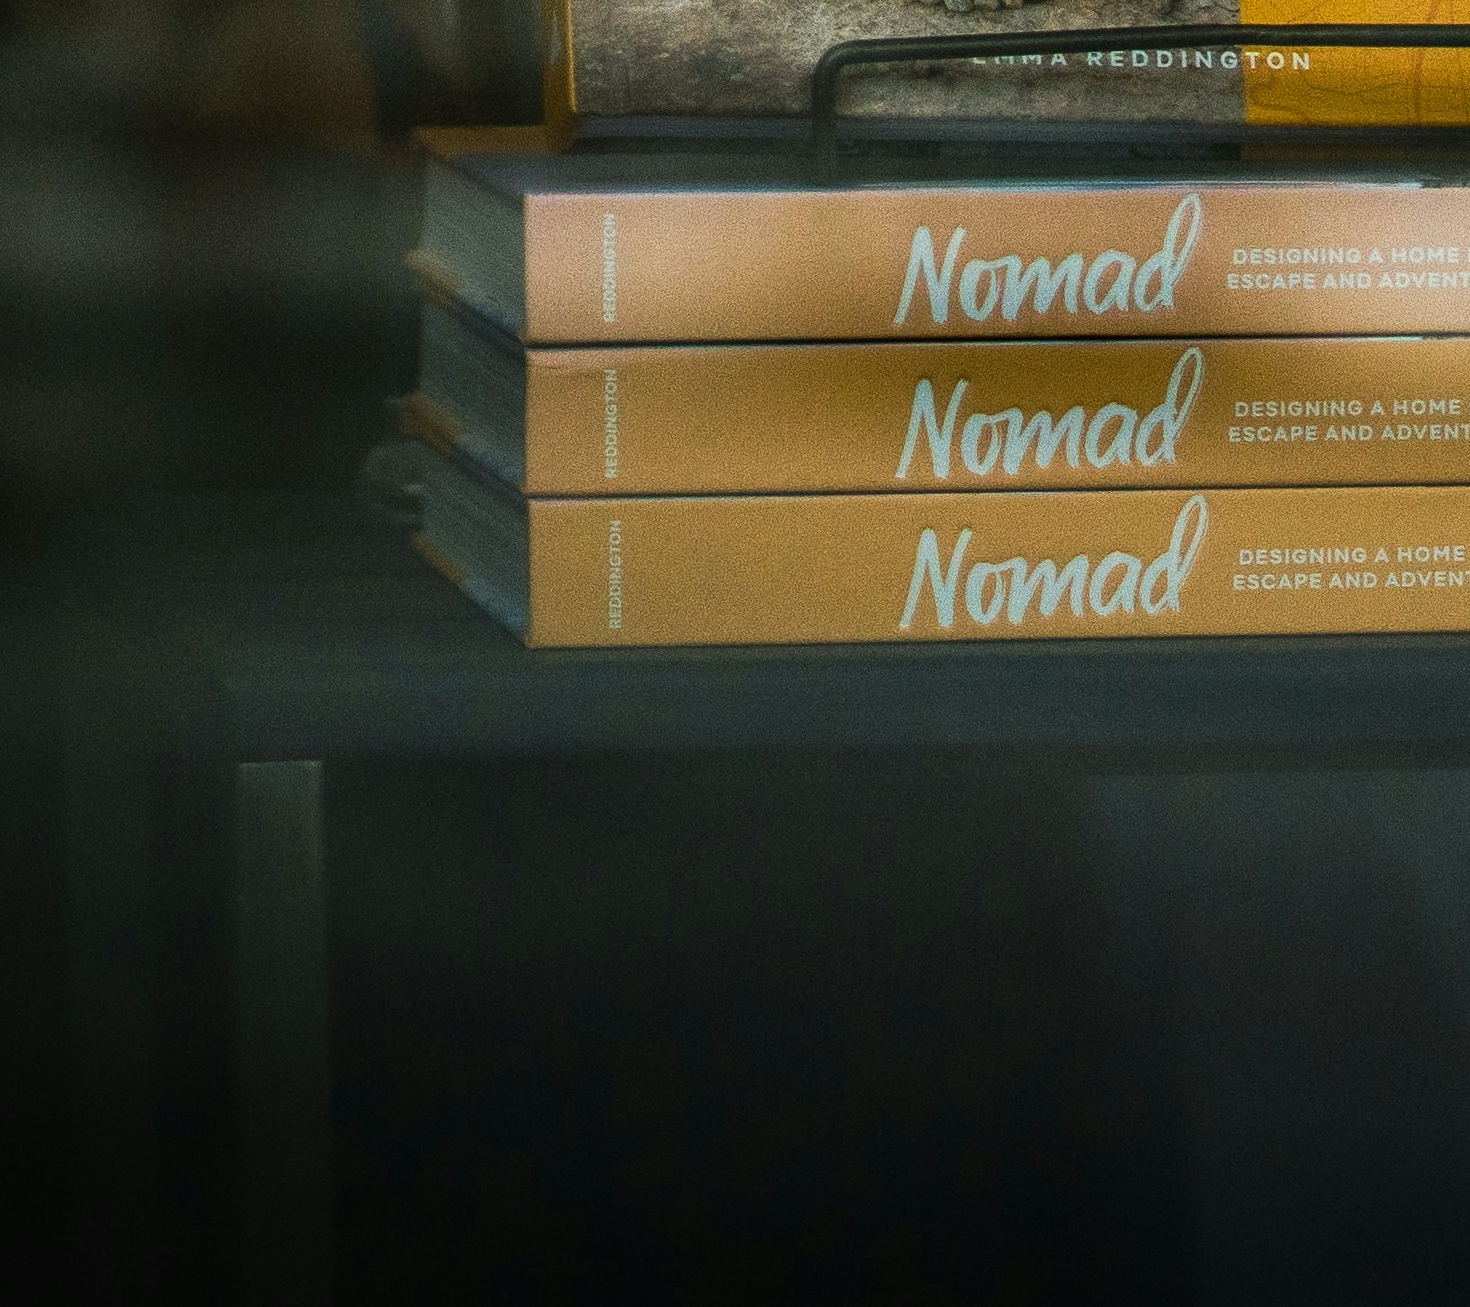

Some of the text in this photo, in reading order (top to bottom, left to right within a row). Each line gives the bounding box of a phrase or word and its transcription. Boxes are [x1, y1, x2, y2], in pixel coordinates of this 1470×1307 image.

[1085, 49, 1311, 71] REDDINGTON
[892, 193, 1202, 327] Nomad
[1233, 247, 1362, 265] DESIGNING
[1368, 247, 1383, 264] A
[1392, 246, 1460, 264] HOME
[1227, 273, 1316, 290] ESCAPE
[1322, 273, 1372, 289] AND
[895, 346, 1204, 481] Nomad
[1234, 400, 1363, 418] DESIGNING
[1370, 400, 1385, 417] A
[1392, 399, 1461, 416] HOME
[604, 369, 618, 479] REDDINGTON
[1229, 425, 1317, 443] ESCAPE
[1325, 425, 1373, 441] AND
[900, 495, 1208, 629] Nomad
[1238, 547, 1367, 565] DESIGNING
[1375, 547, 1390, 564] A
[1398, 545, 1466, 563] HOME
[608, 519, 622, 629] REDDINGTON
[1233, 573, 1322, 590] ESCAPE
[1329, 572, 1378, 589] AND
